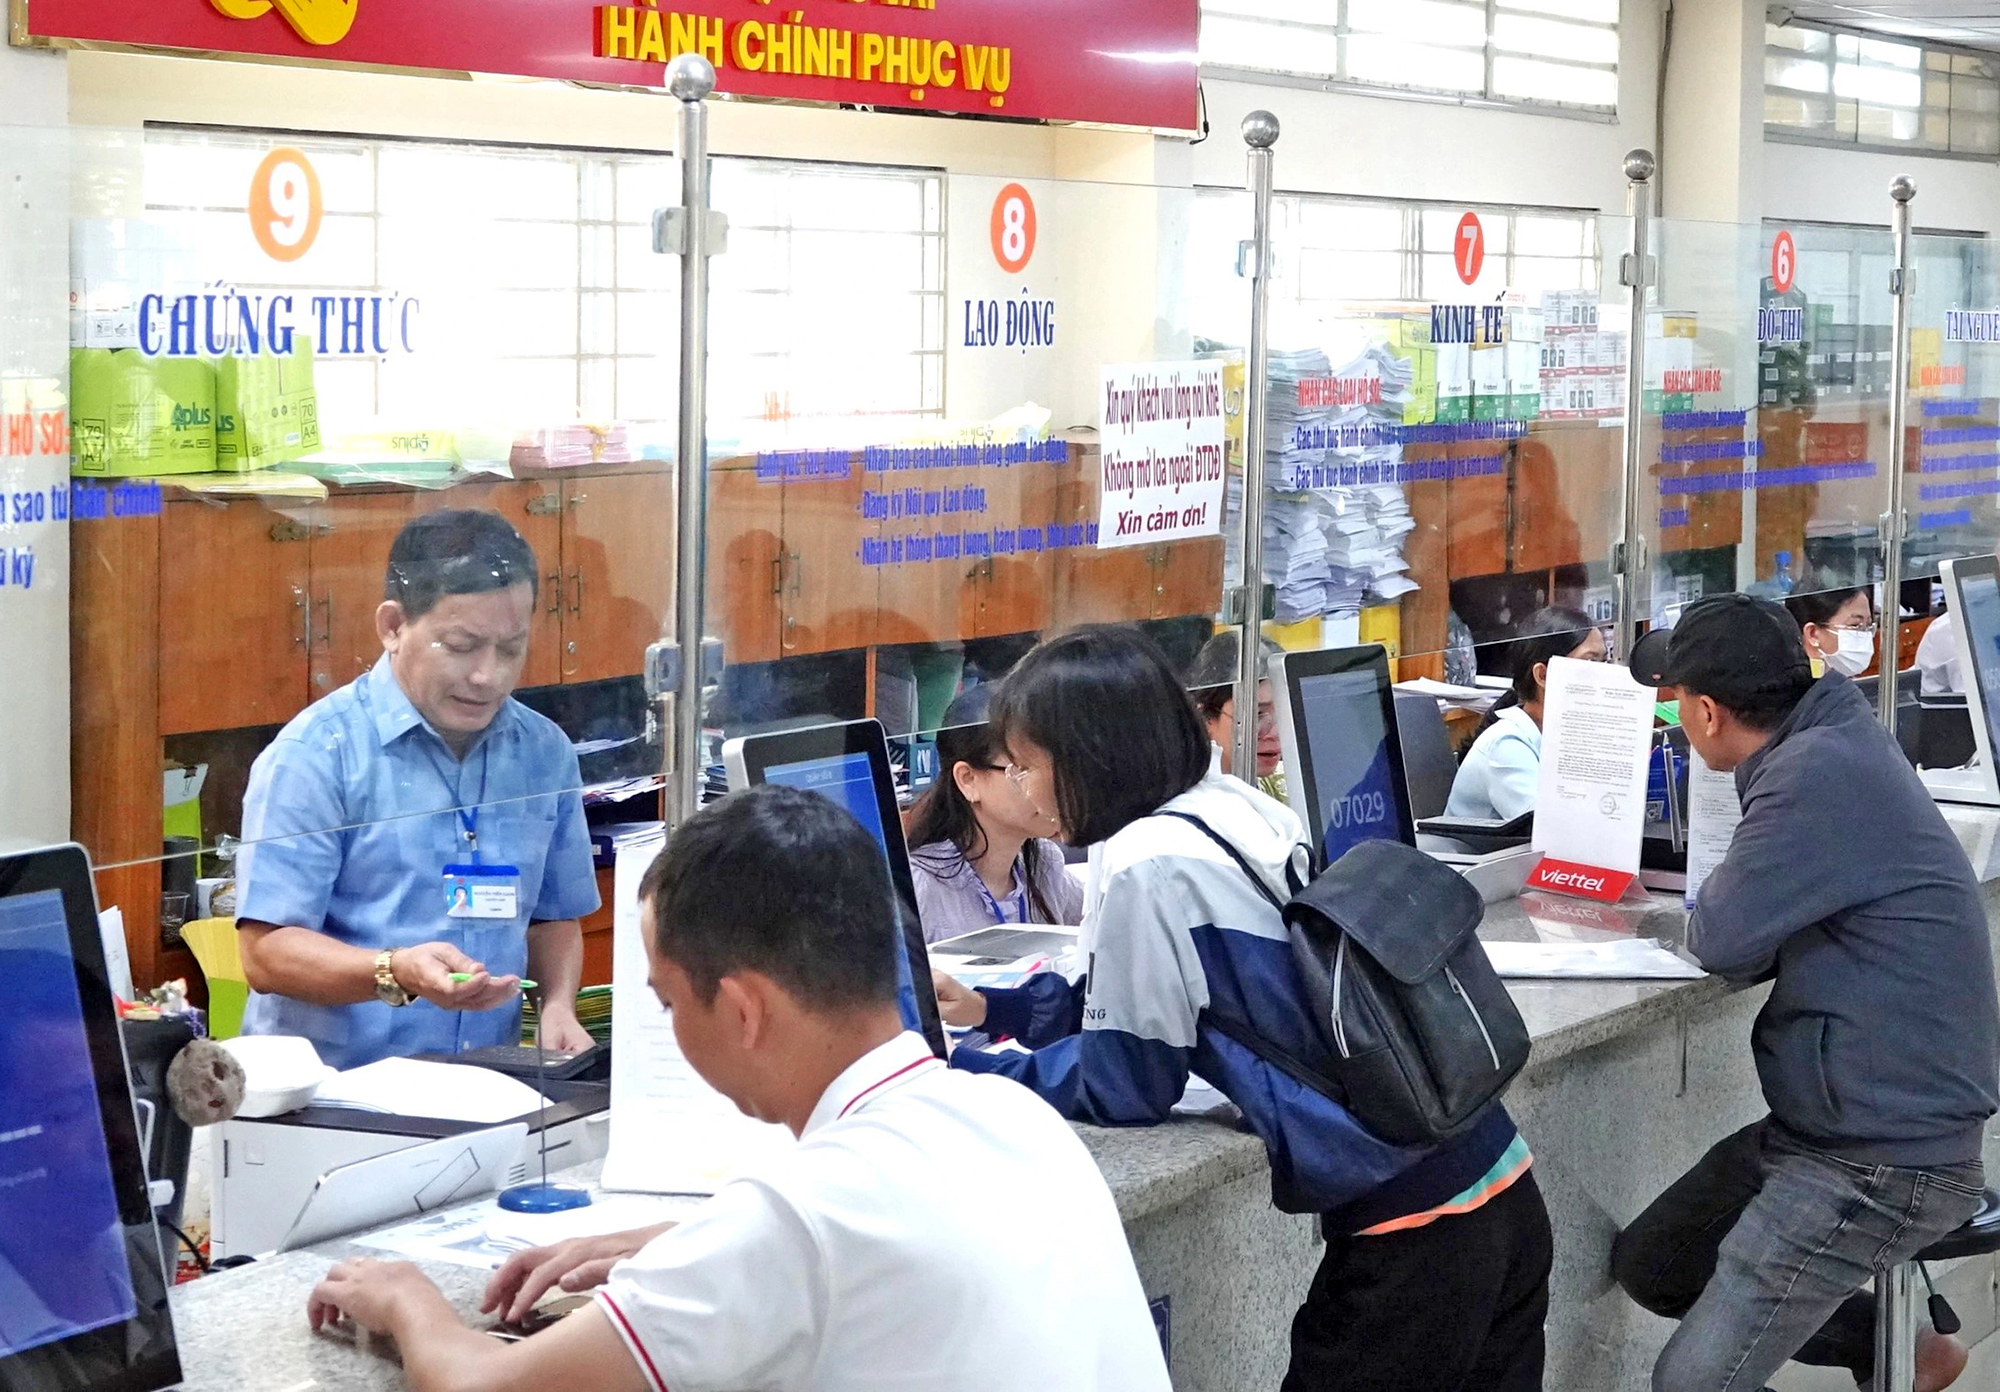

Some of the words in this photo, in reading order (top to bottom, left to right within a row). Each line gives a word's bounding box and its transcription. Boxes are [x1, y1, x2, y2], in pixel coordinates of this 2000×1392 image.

[602, 0, 722, 67] HÀNH
[735, 11, 851, 78] CHÍNH
[859, 33, 956, 101] PHỤC
[962, 44, 1010, 107] VỤ
[269, 161, 309, 246] 9
[1002, 197, 1026, 262] 8
[1462, 225, 1478, 276] 7
[1777, 239, 1791, 283] 6
[139, 280, 295, 356] CHỨNG
[312, 290, 420, 363] THỰC
[964, 300, 999, 346] LAO
[1005, 287, 1054, 353] ĐỘNG
[1430, 305, 1476, 343] KINH
[1482, 291, 1506, 343] TẾ
[1757, 300, 1775, 341] ĐÔ
[1946, 303, 1963, 340] TÀI
[302, 404, 314, 418] 70
[1106, 379, 1119, 424] Xin
[1120, 373, 1135, 435] quý
[1137, 373, 1159, 422] khách
[1161, 375, 1173, 420] vui
[1174, 371, 1190, 429] lòng
[1193, 370, 1204, 418] nói
[1205, 371, 1219, 417] khẽ
[303, 425, 316, 439] A4
[1296, 425, 1311, 449] Các
[1104, 449, 1133, 499] Không
[1136, 446, 1151, 488] mở
[1153, 448, 1166, 486] loa
[1169, 443, 1193, 494] ngoài
[1195, 444, 1220, 482] ĐTDĐ
[1295, 464, 1310, 489] Các
[1312, 461, 1325, 488] thủ
[1326, 465, 1338, 493] tục
[1339, 462, 1358, 486] hành
[12, 491, 45, 523] sao
[943, 485, 960, 512] Lao
[1116, 509, 1141, 536] Xin
[1146, 504, 1178, 531] cảm
[1182, 502, 1207, 527] ơn!
[12, 545, 34, 589] ký
[1330, 790, 1384, 828] 07029
[1540, 867, 1605, 892] viettel
